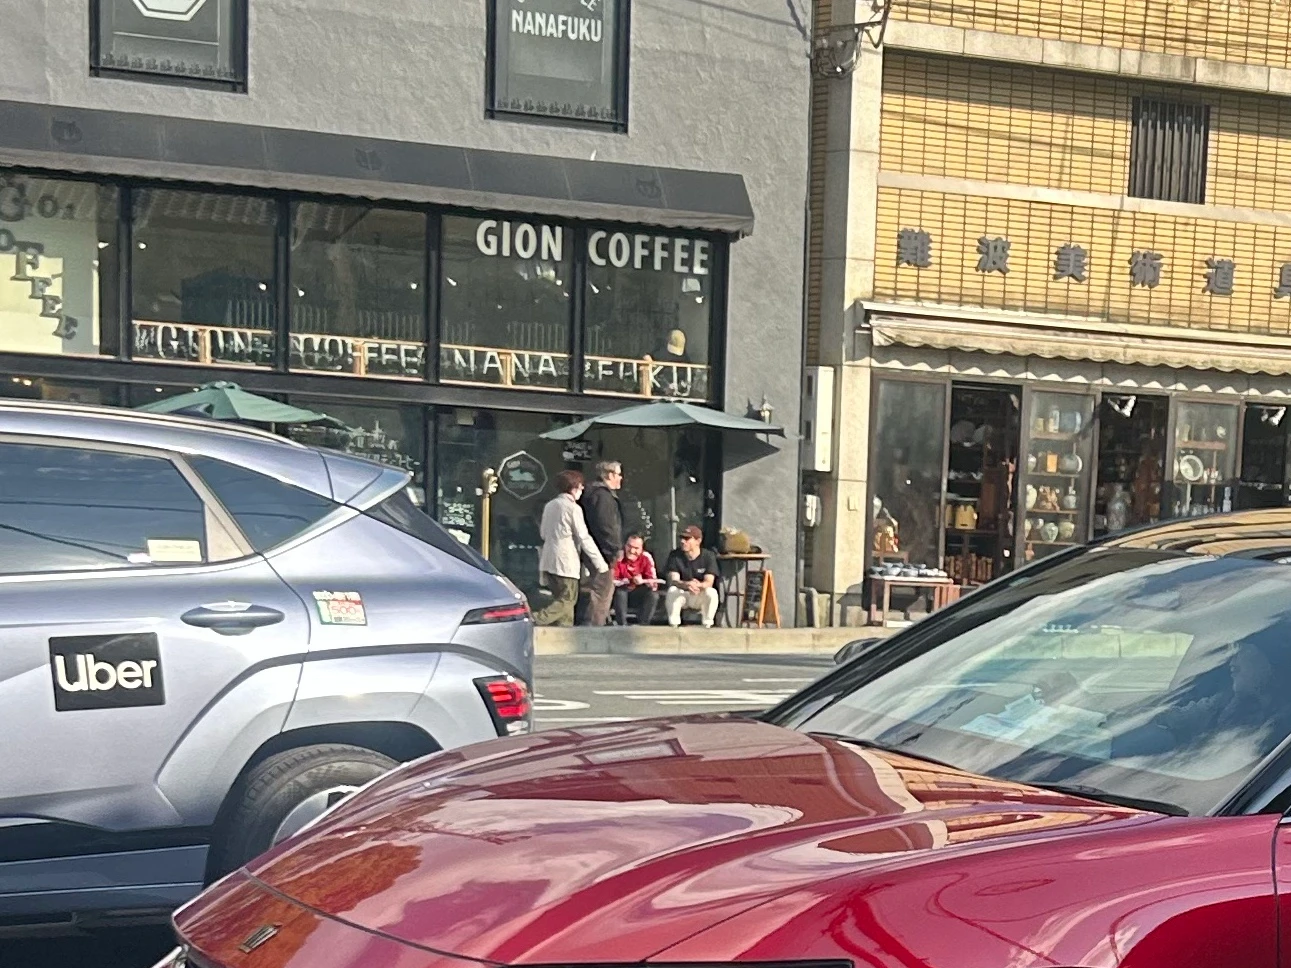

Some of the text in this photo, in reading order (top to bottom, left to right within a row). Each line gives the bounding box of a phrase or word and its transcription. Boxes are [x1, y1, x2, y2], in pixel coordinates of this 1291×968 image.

[511, 9, 602, 42] NANAFUKU
[476, 219, 710, 275] GION COFFEE
[55, 653, 157, 691] Uber
